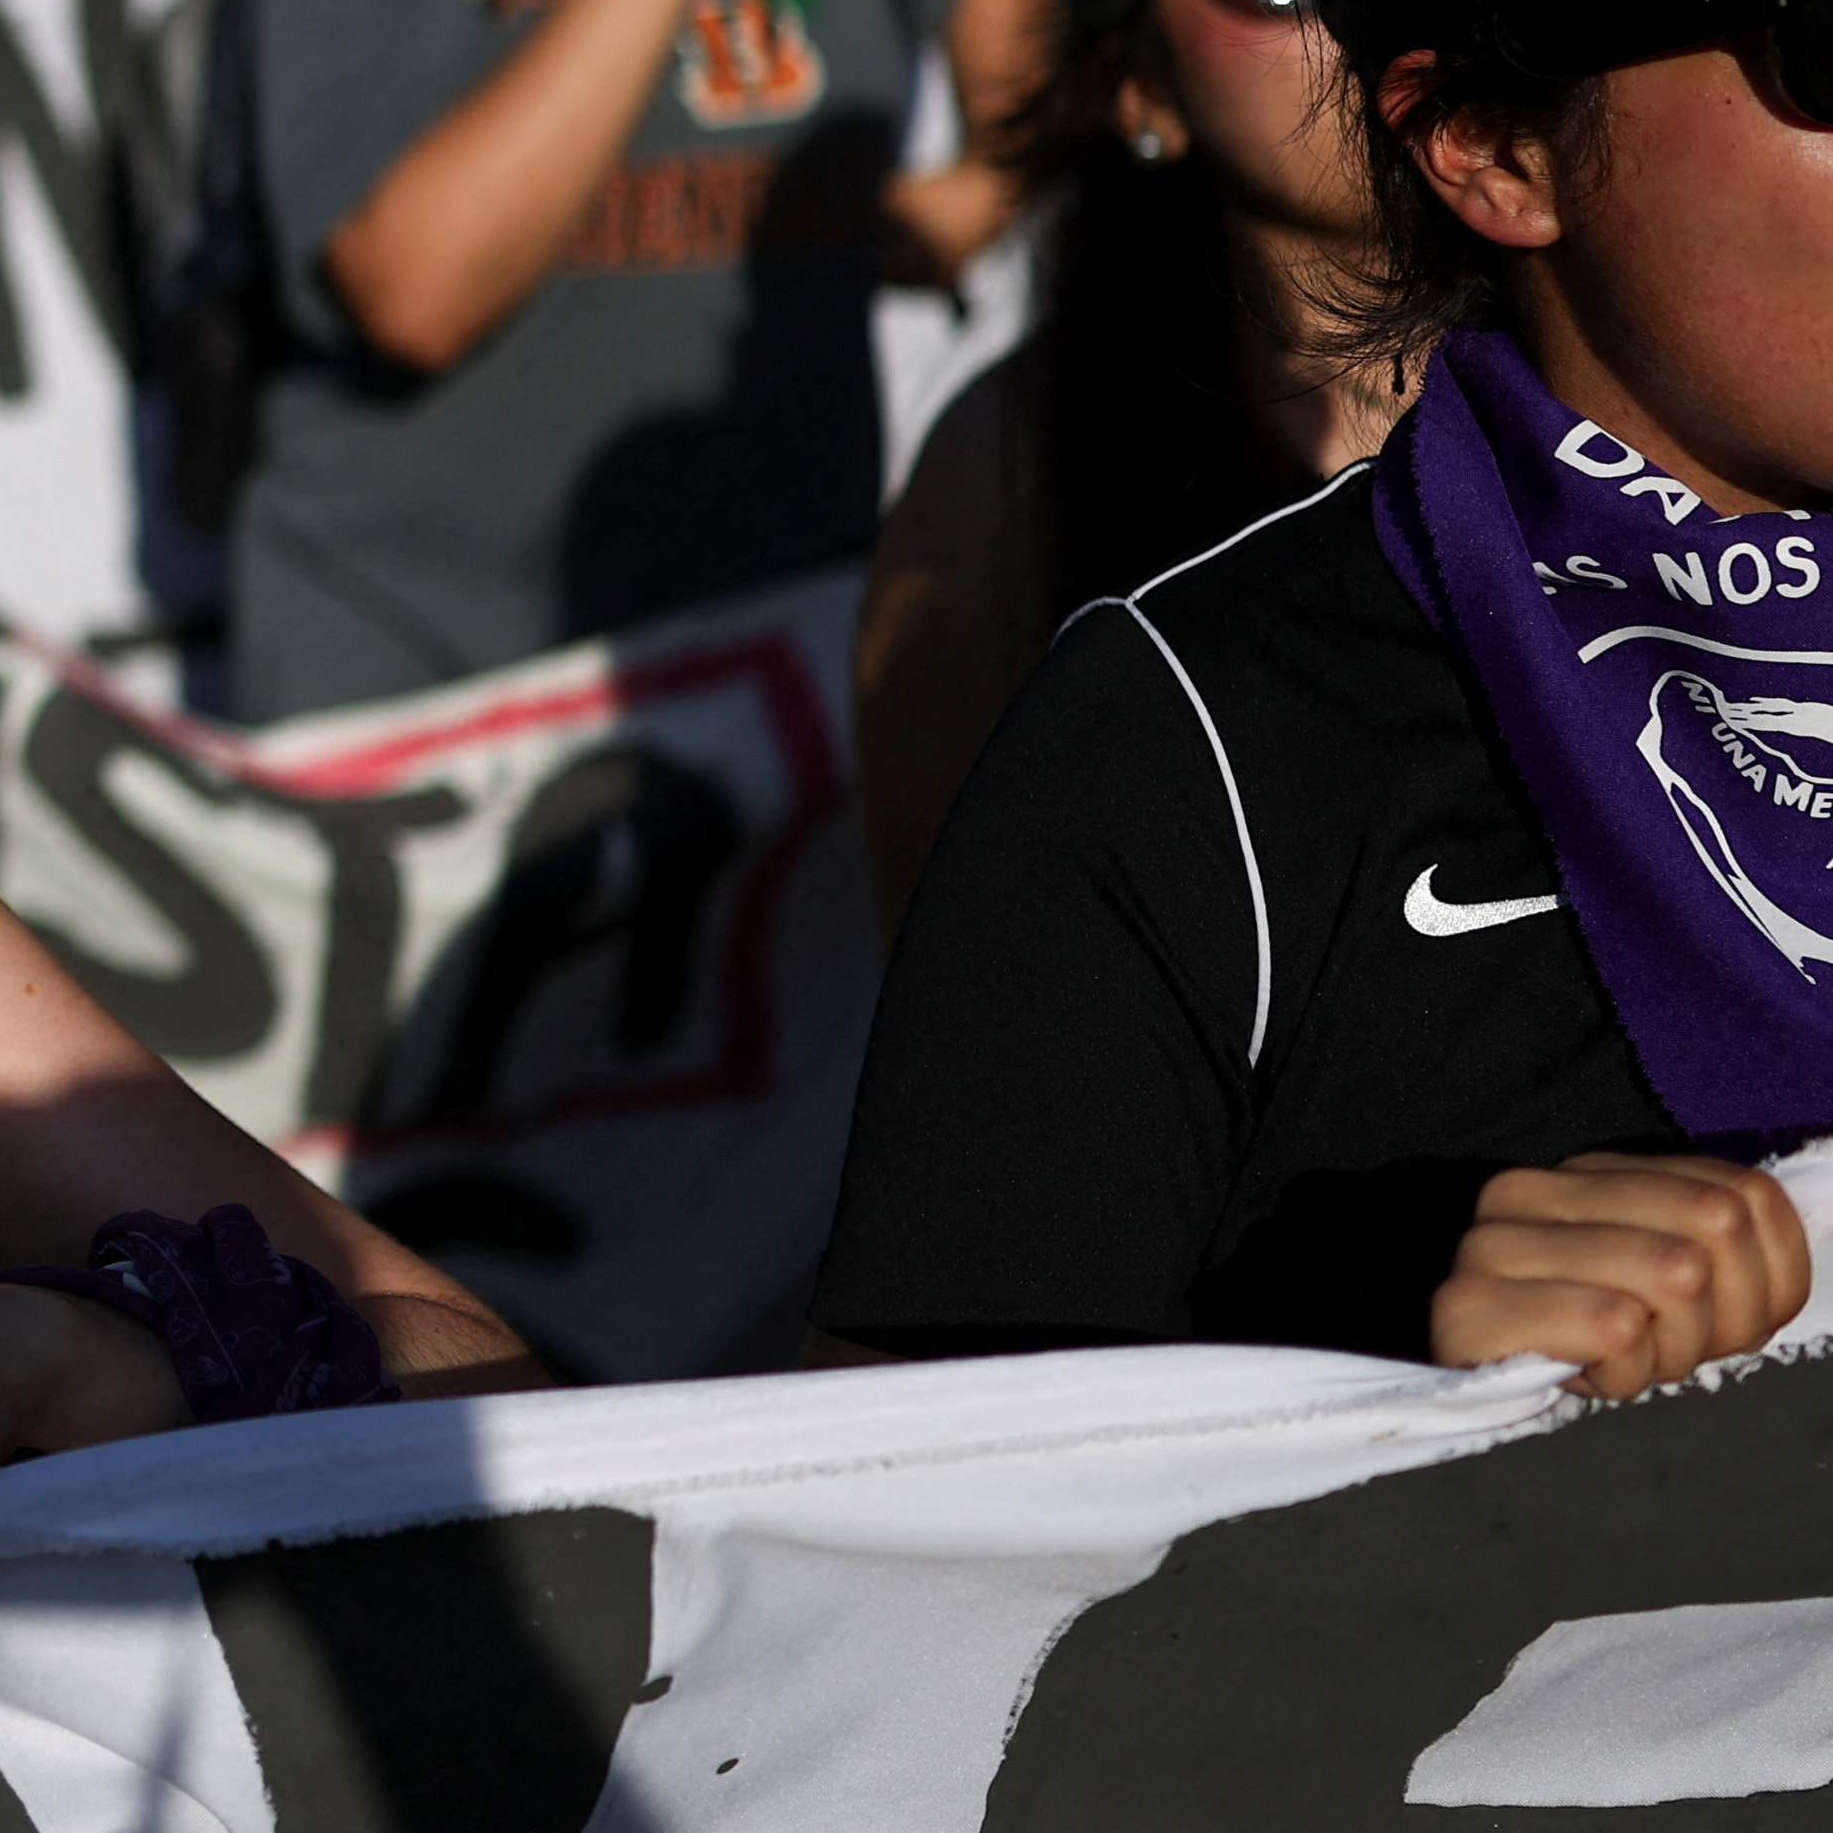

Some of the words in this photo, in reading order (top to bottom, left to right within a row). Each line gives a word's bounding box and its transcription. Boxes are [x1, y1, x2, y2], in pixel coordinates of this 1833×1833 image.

[1652, 535, 1821, 606] NOS
[1680, 680, 1717, 714] NI
[1711, 721, 1767, 793] UNA
